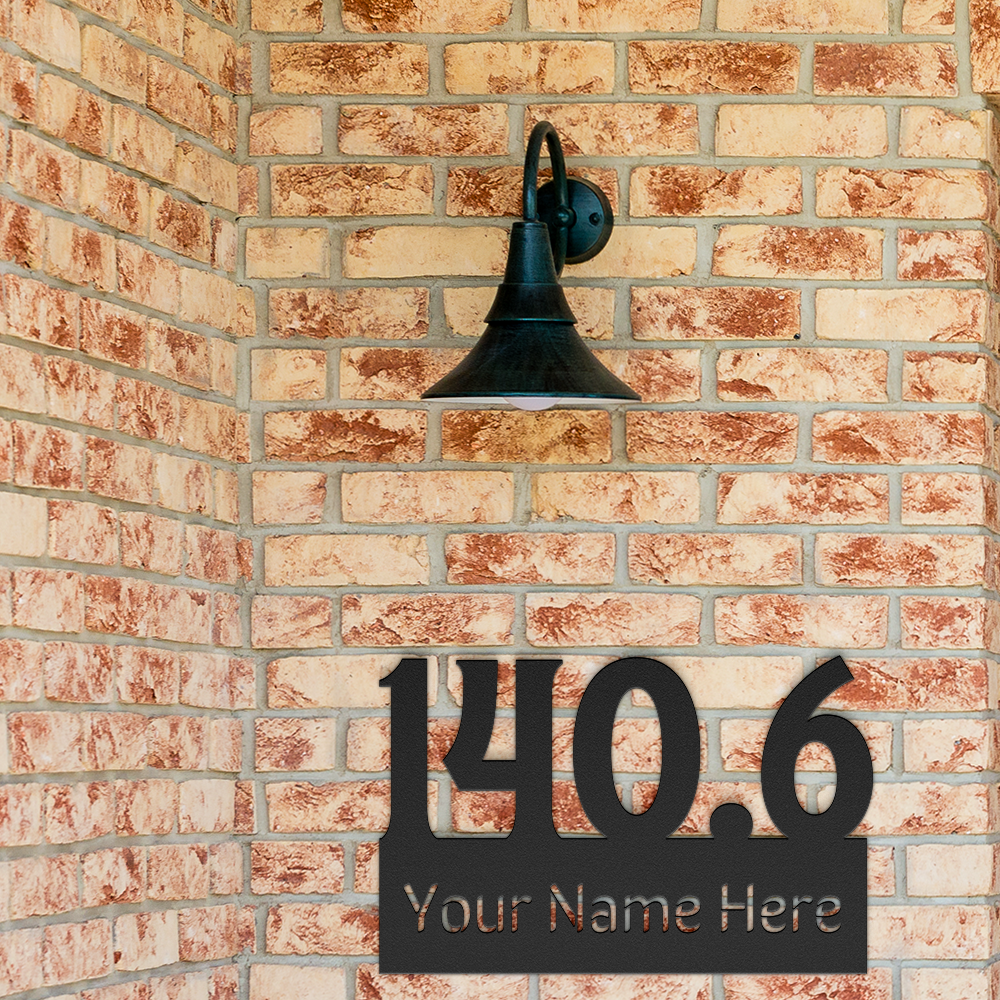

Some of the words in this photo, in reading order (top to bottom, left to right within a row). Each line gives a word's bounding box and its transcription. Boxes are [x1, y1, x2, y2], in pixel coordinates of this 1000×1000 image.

[379, 655, 874, 841] 140.6
[403, 883, 532, 934] Your
[549, 883, 702, 934] Name
[719, 883, 842, 934] Here
